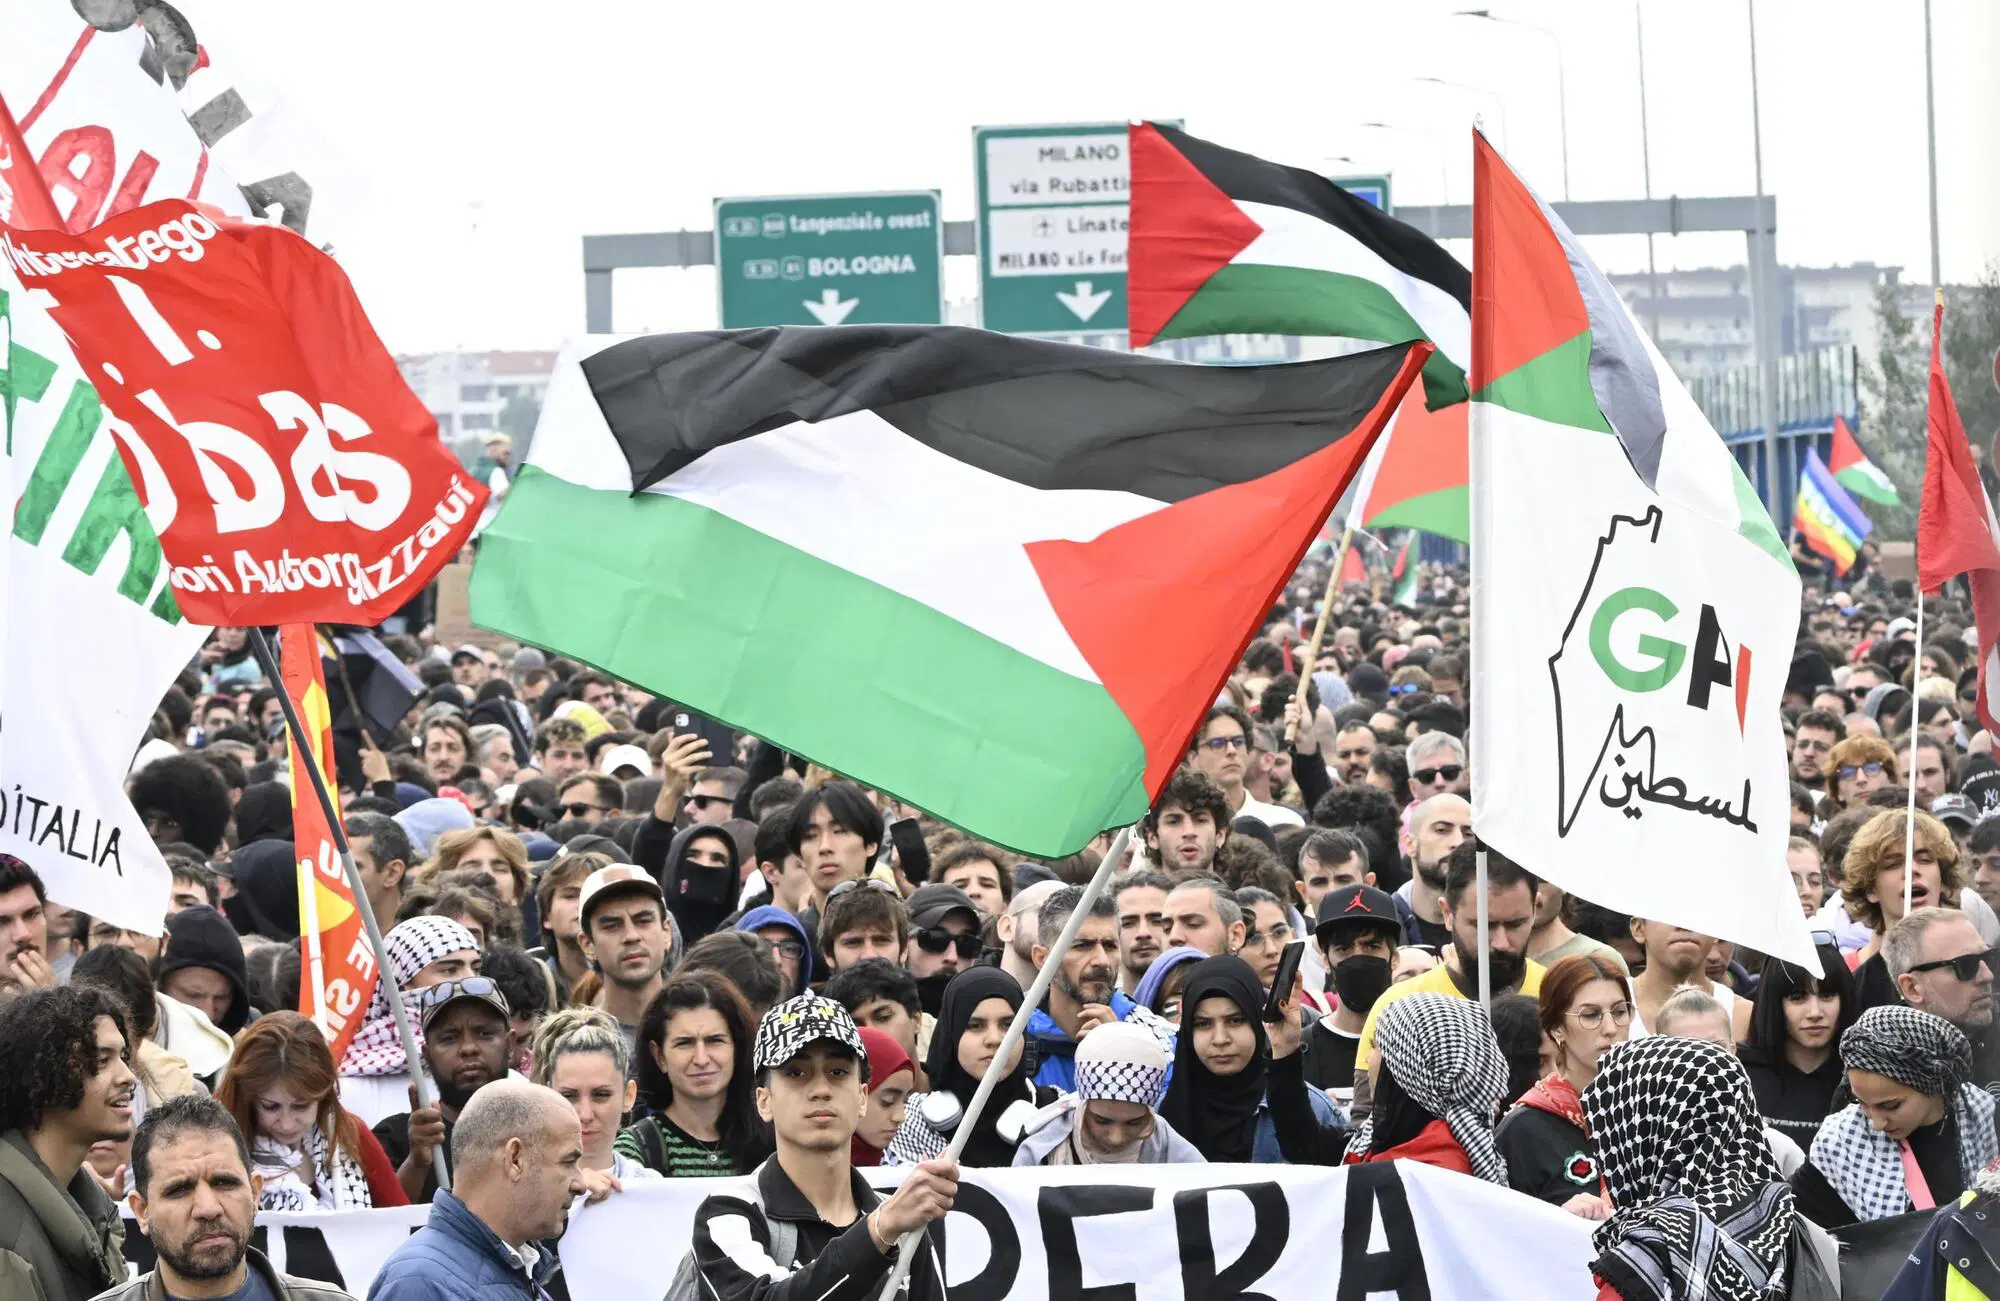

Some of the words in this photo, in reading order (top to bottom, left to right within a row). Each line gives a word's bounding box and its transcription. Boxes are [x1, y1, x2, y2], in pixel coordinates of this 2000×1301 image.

[1038, 144, 1119, 162] MILANO
[1010, 178, 1038, 194] via
[1049, 176, 1129, 193] Rubatti
[789, 211, 884, 236] tangenziale
[886, 209, 931, 230] ovest
[807, 254, 916, 278] BOLOGNA
[999, 252, 1060, 268] MILANO
[1984, 788, 1999, 806] NY
